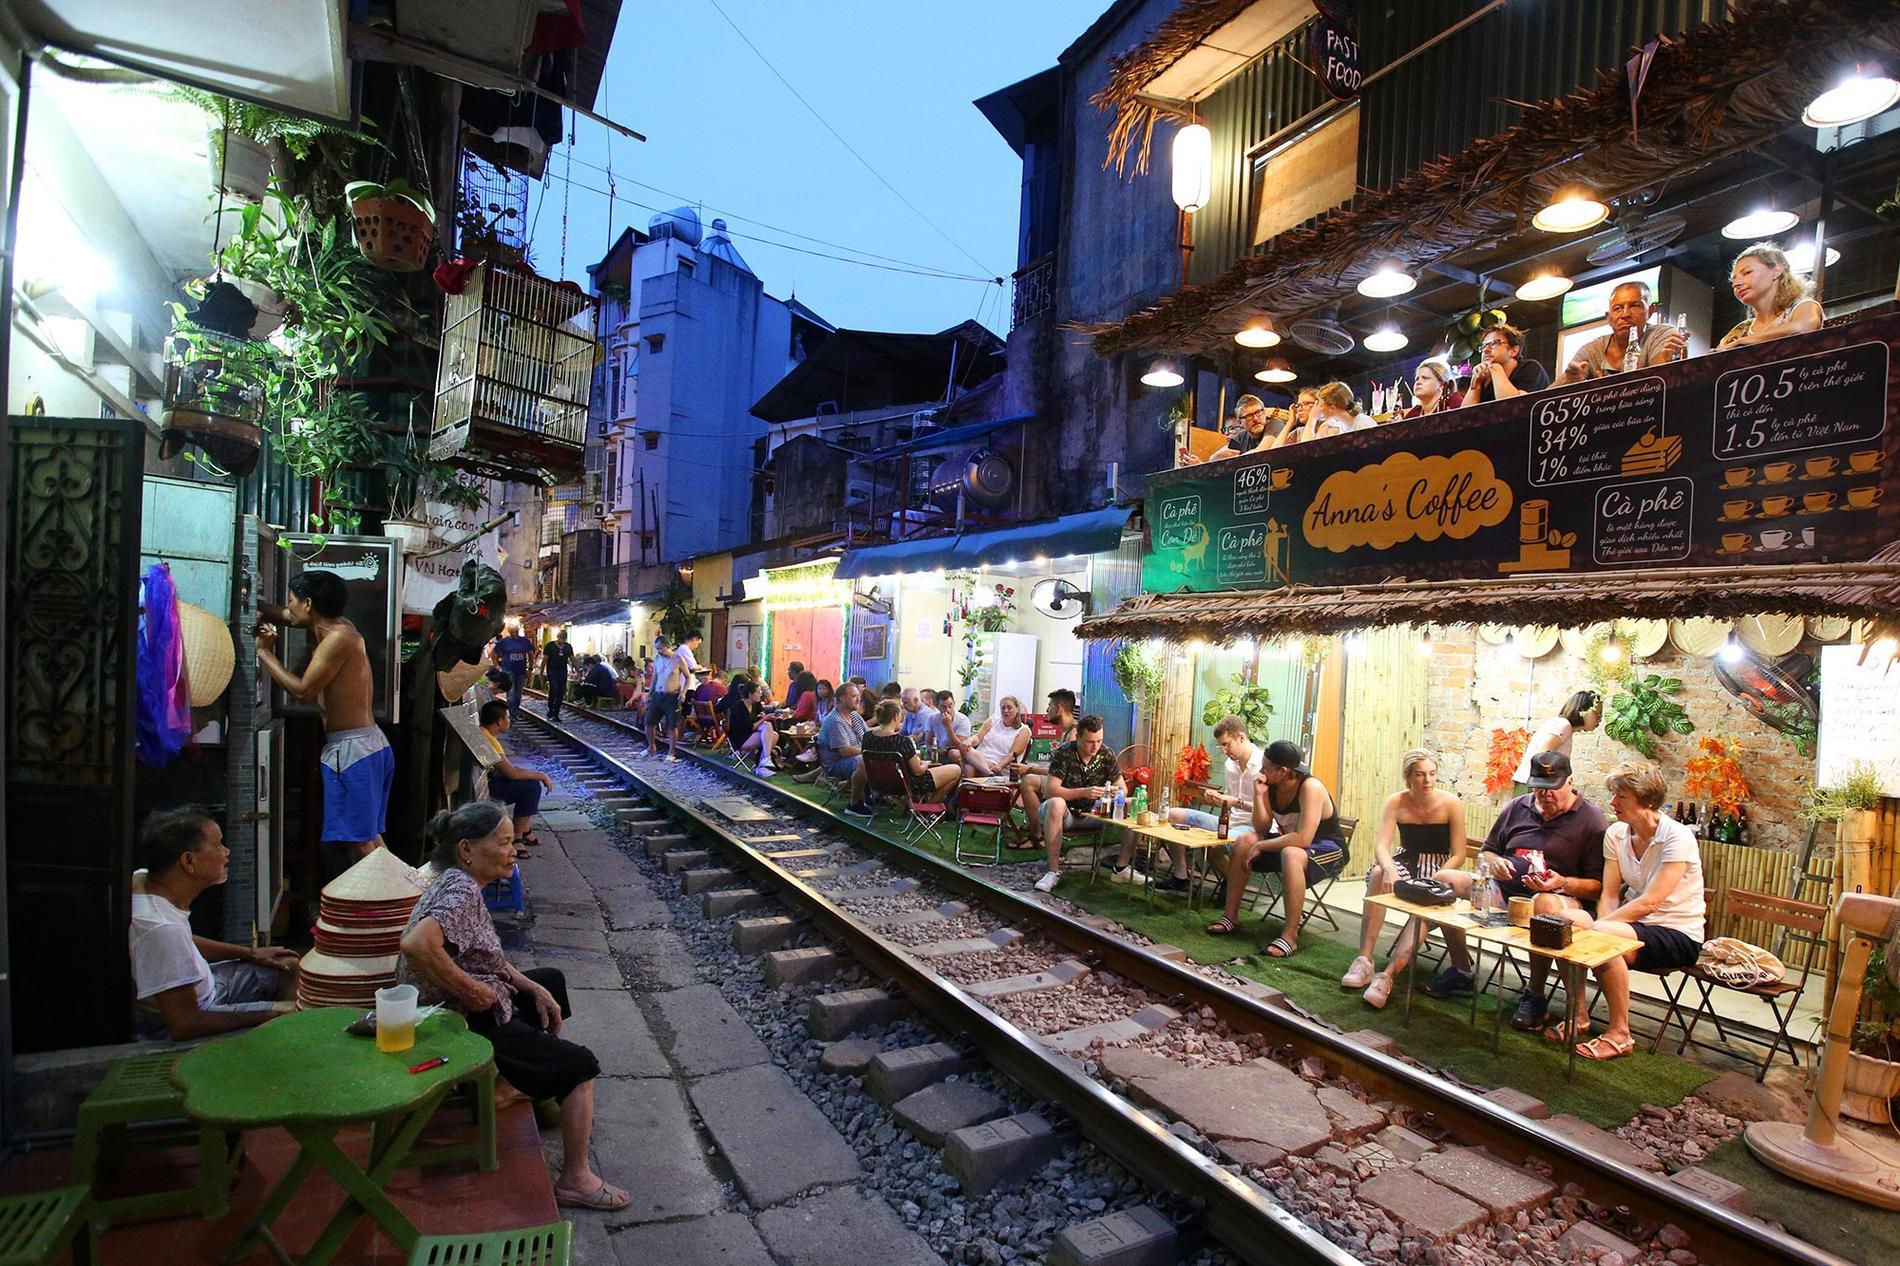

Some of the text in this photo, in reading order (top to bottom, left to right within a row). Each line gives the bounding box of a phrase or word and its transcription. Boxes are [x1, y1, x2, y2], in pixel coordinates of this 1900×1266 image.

[1327, 29, 1360, 61] FAST
[1327, 56, 1362, 91] FOOD
[1826, 360, 1848, 374] phê
[1723, 367, 1796, 408] 10.5
[1540, 394, 1590, 426] 65%
[1538, 423, 1587, 454] 34%
[1721, 418, 1768, 452] 1.5
[1833, 421, 1861, 434] Nam
[1238, 466, 1267, 488] 46%
[1536, 455, 1567, 482] 1%
[1163, 500, 1198, 521] Cà phê
[1312, 471, 1499, 530] Anna's Coffee
[1602, 486, 1685, 520] Cà phê
[1221, 529, 1264, 552] Cà phê
